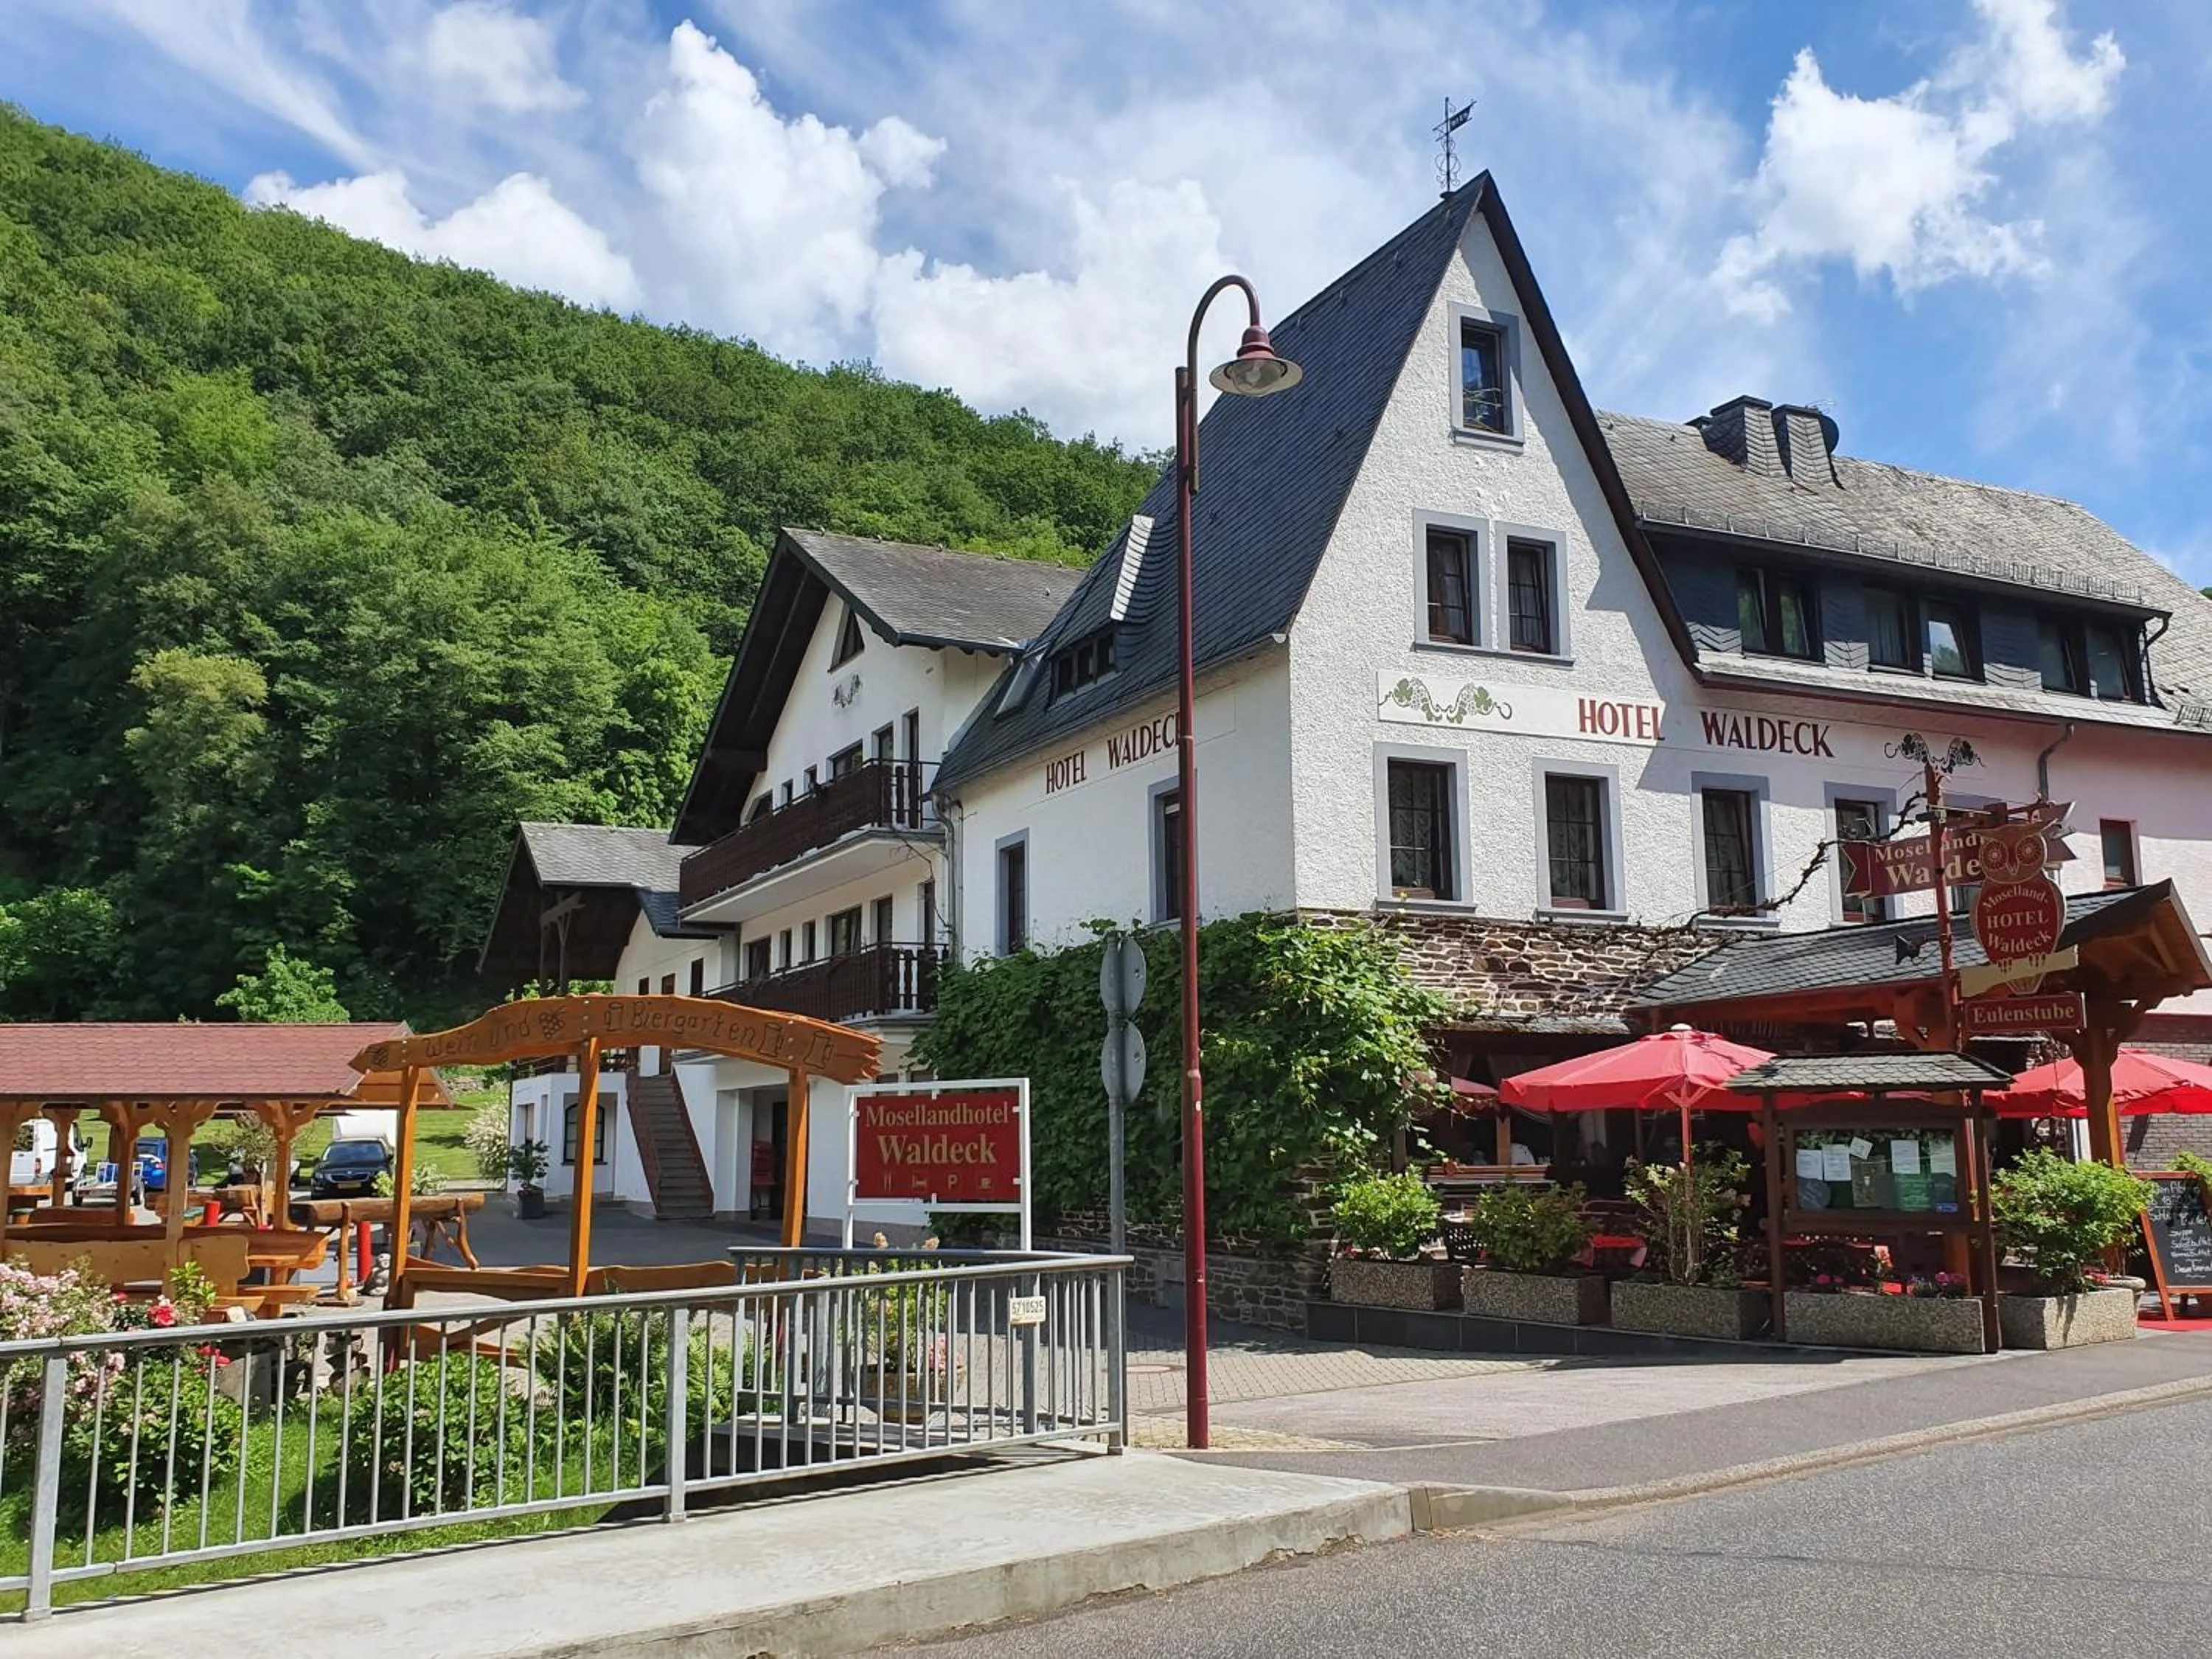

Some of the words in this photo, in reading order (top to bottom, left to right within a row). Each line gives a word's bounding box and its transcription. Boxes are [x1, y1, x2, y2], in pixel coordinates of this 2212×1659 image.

[1578, 698, 1666, 741] HOTEL
[1700, 711, 1836, 758] WALDECK
[1046, 750, 1087, 794] HOTEL
[1885, 855, 1982, 888] Wade
[1986, 909, 2049, 929] HOTEL
[1989, 930, 2052, 953] Waldeck
[1973, 1002, 2076, 1023] Eulenstube
[422, 1034, 478, 1057] Wein
[866, 1101, 1009, 1127] Mosellandhotel
[877, 1133, 997, 1165] Waldeck
